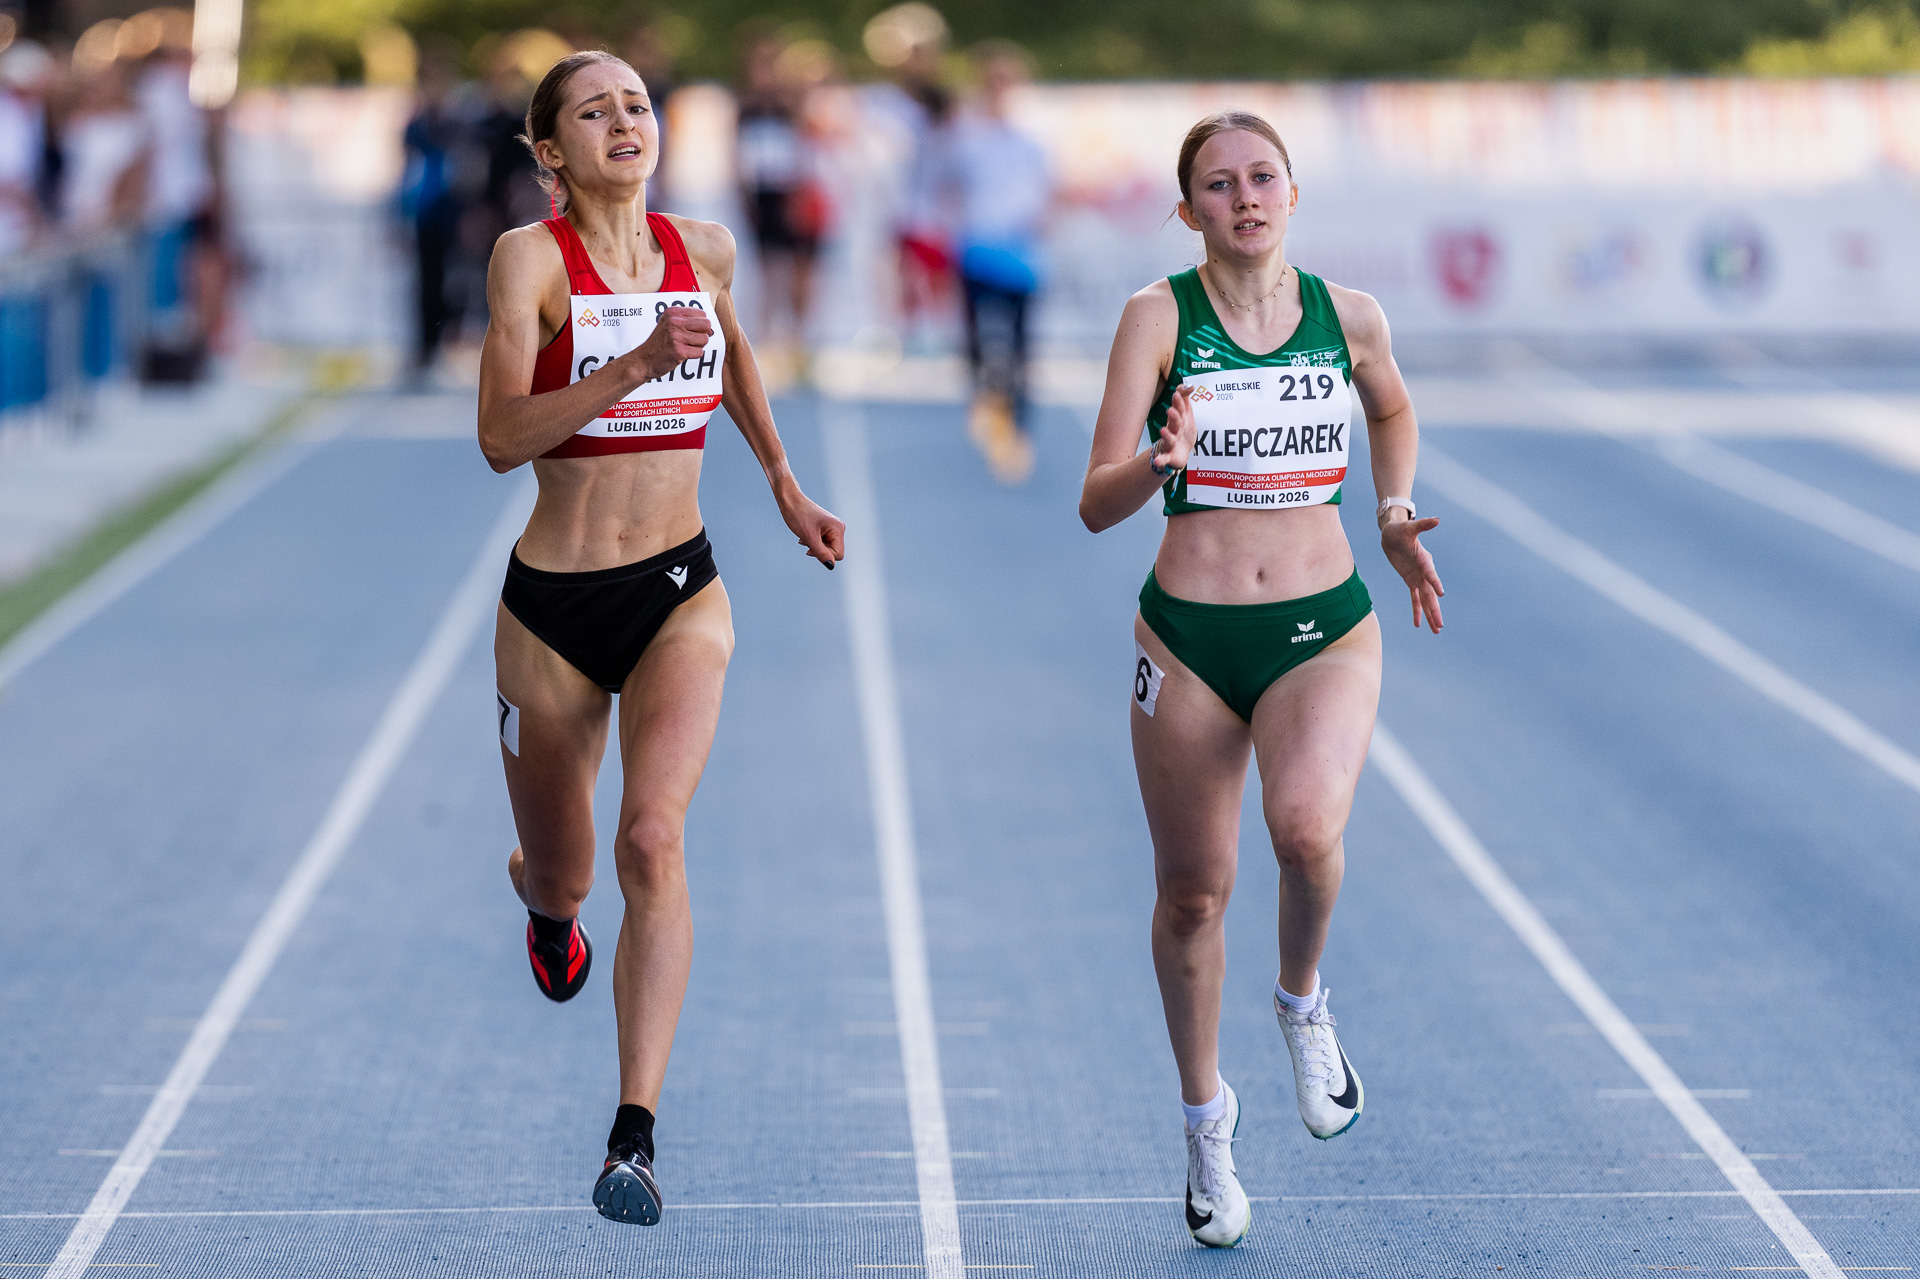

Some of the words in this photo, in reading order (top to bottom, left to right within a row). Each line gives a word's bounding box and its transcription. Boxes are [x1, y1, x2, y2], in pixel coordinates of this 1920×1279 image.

[602, 307, 643, 318] LUBELSKIE
[602, 319, 621, 327] 2026
[1191, 359, 1221, 369] erima
[1215, 381, 1261, 392] LUBELSKIE
[1278, 374, 1334, 401] 219
[609, 401, 648, 410] LNOPOLSKA
[648, 399, 681, 408] OLIMPIADA
[681, 396, 715, 405] MŁODZIEŻY
[1216, 392, 1234, 401] 2026
[623, 408, 656, 417] SPORTACH
[656, 406, 681, 415] LETNICH
[607, 421, 652, 432] LUBLIN
[654, 418, 686, 430] 2026
[1194, 422, 1345, 458] KLEPCZAREK
[1196, 471, 1215, 479] XXXII
[1216, 471, 1271, 482] OGÓLNOPOLSKA
[1272, 473, 1305, 482] OLIMPIADA
[1306, 468, 1340, 479] MŁODZIEŻY
[1242, 481, 1278, 489] SPORTACH
[1279, 480, 1305, 488] LETNICH
[1227, 492, 1275, 504] LUBLIN
[1278, 490, 1310, 503] 2026
[1291, 630, 1324, 643] erima
[1135, 656, 1152, 702] 6
[497, 691, 511, 738] 7
